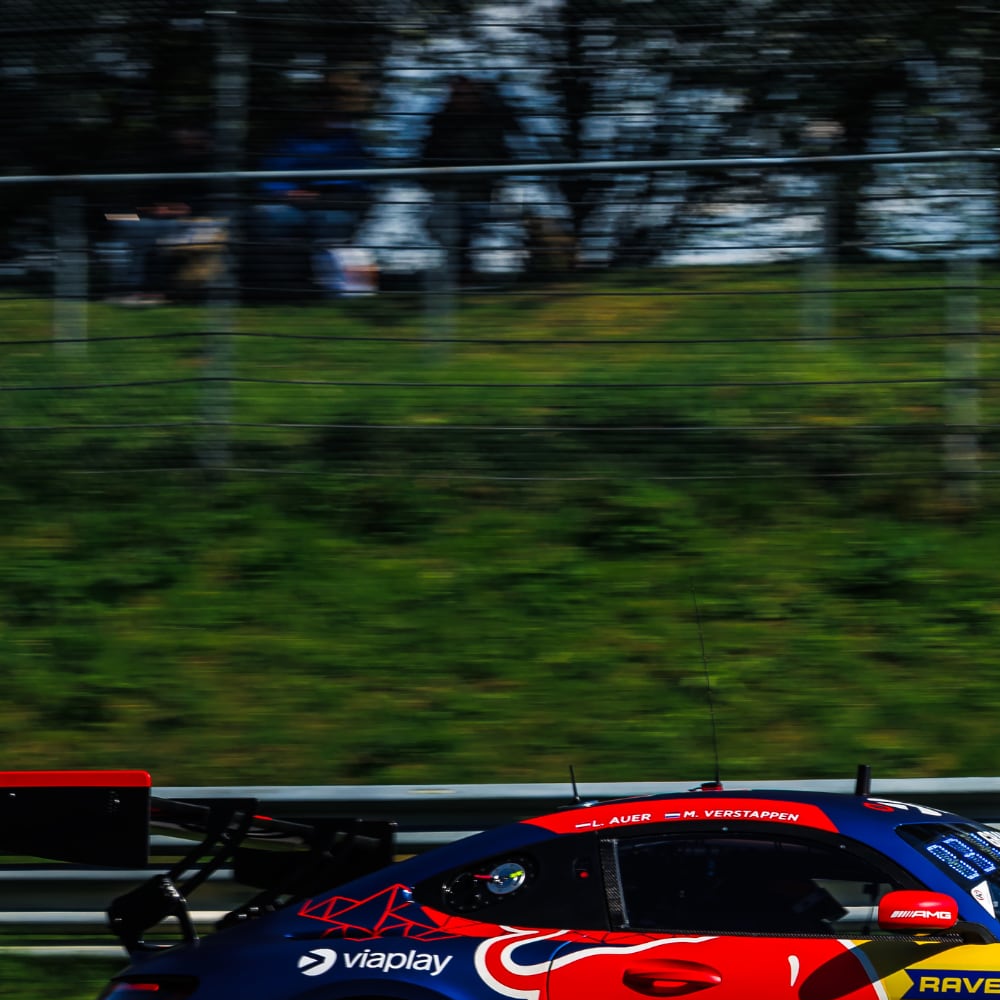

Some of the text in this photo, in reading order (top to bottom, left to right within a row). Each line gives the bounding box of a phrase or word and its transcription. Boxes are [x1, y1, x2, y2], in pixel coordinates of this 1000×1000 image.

[591, 813, 651, 828] L. AUER
[683, 810, 799, 822] M. VERSTAPPEN
[343, 949, 453, 977] viaplay
